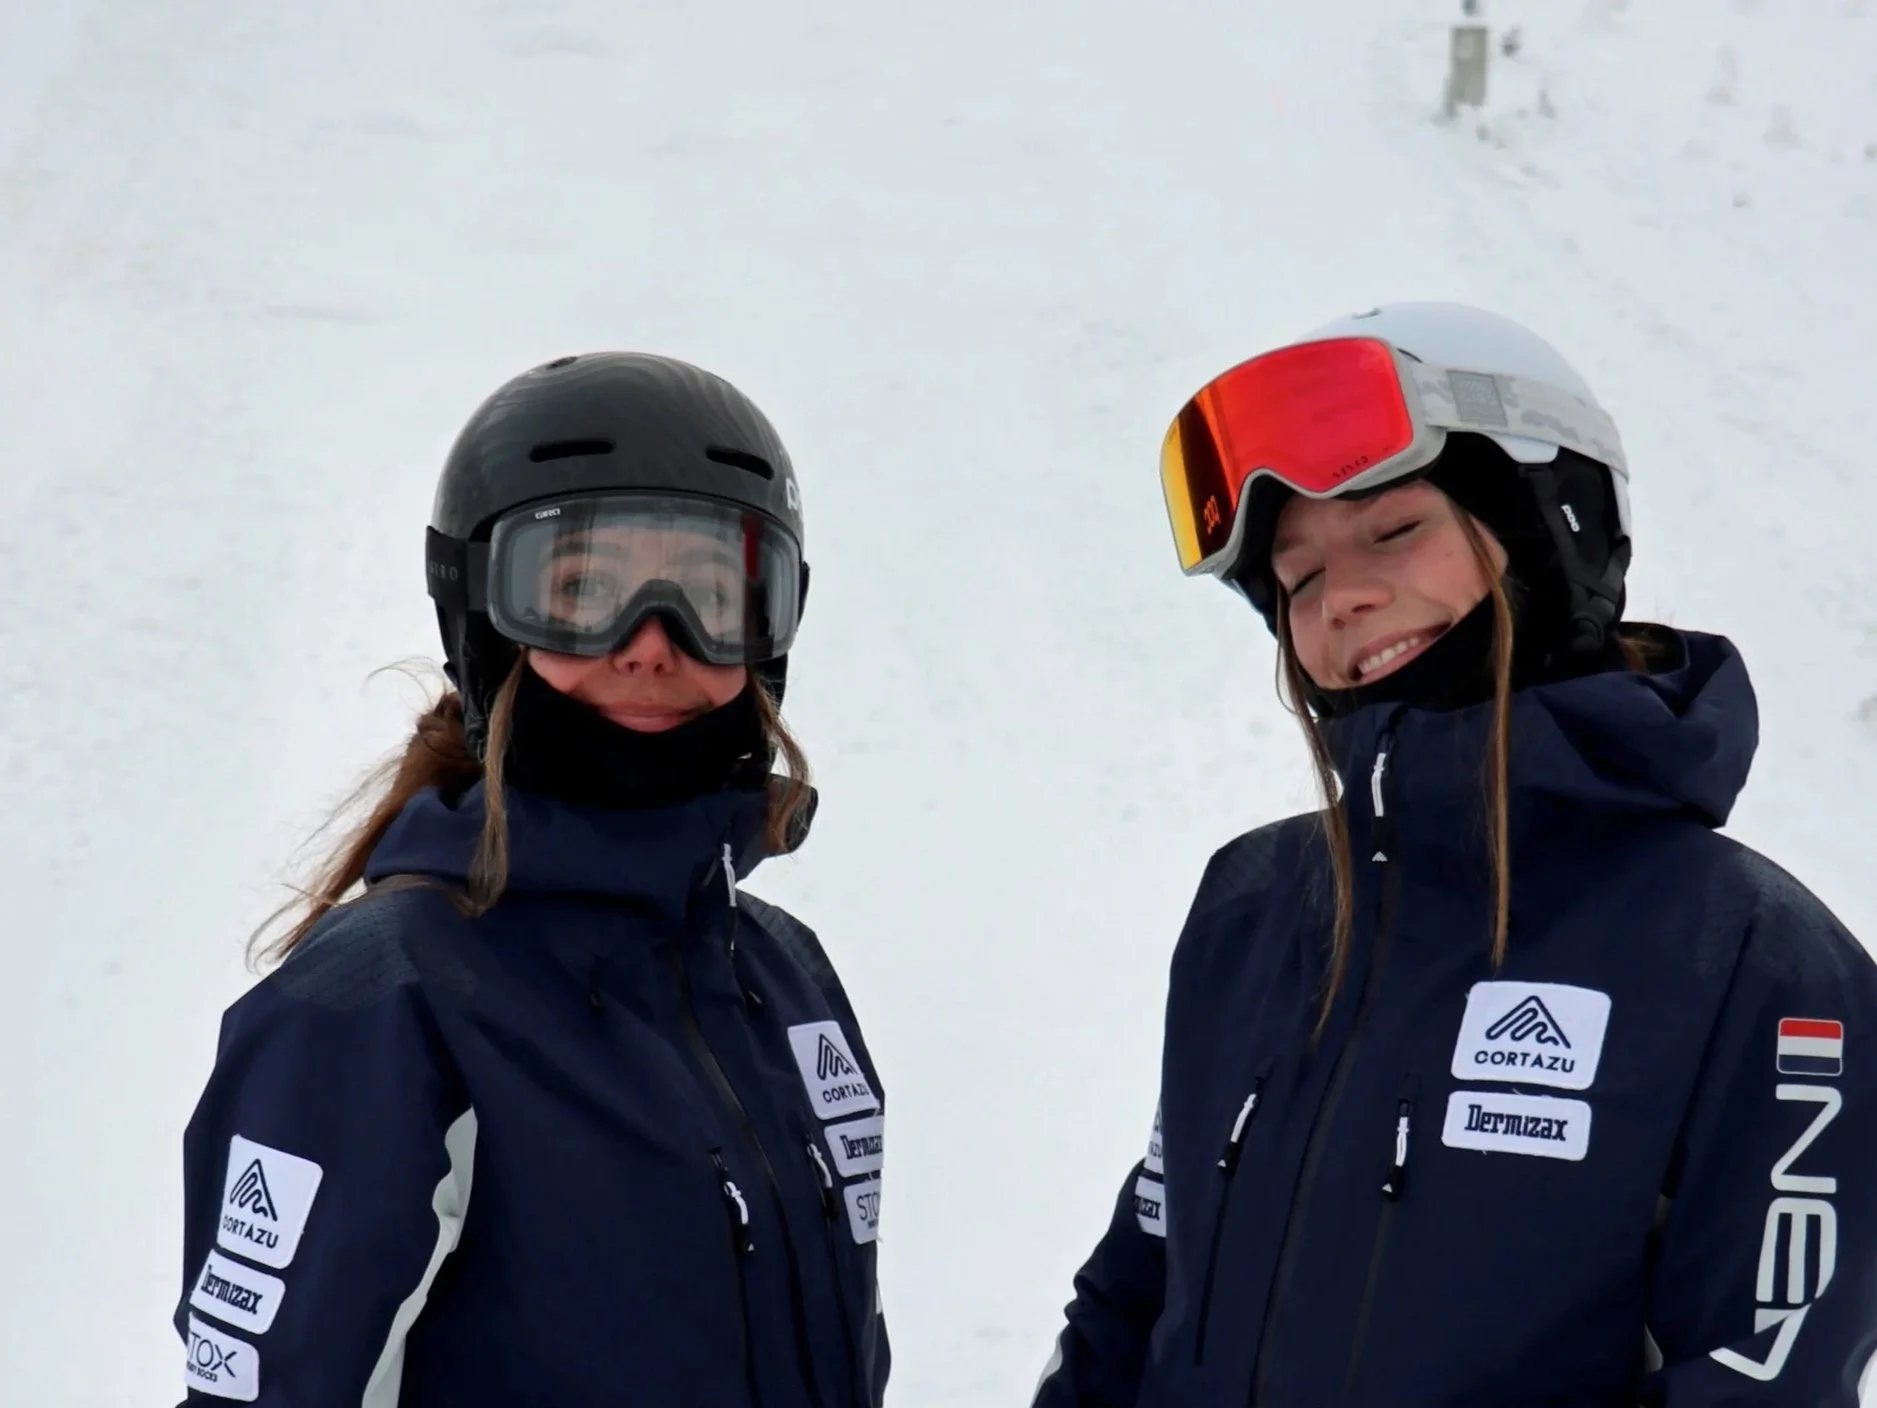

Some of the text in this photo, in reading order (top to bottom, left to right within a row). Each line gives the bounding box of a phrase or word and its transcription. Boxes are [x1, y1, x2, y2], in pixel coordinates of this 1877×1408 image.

[534, 507, 561, 520] GIRO
[1474, 1050, 1576, 1073] CORTAZU
[1464, 1104, 1568, 1141] Dermizax
[222, 1215, 279, 1249] CORTAZU
[190, 1331, 238, 1379] TOX
